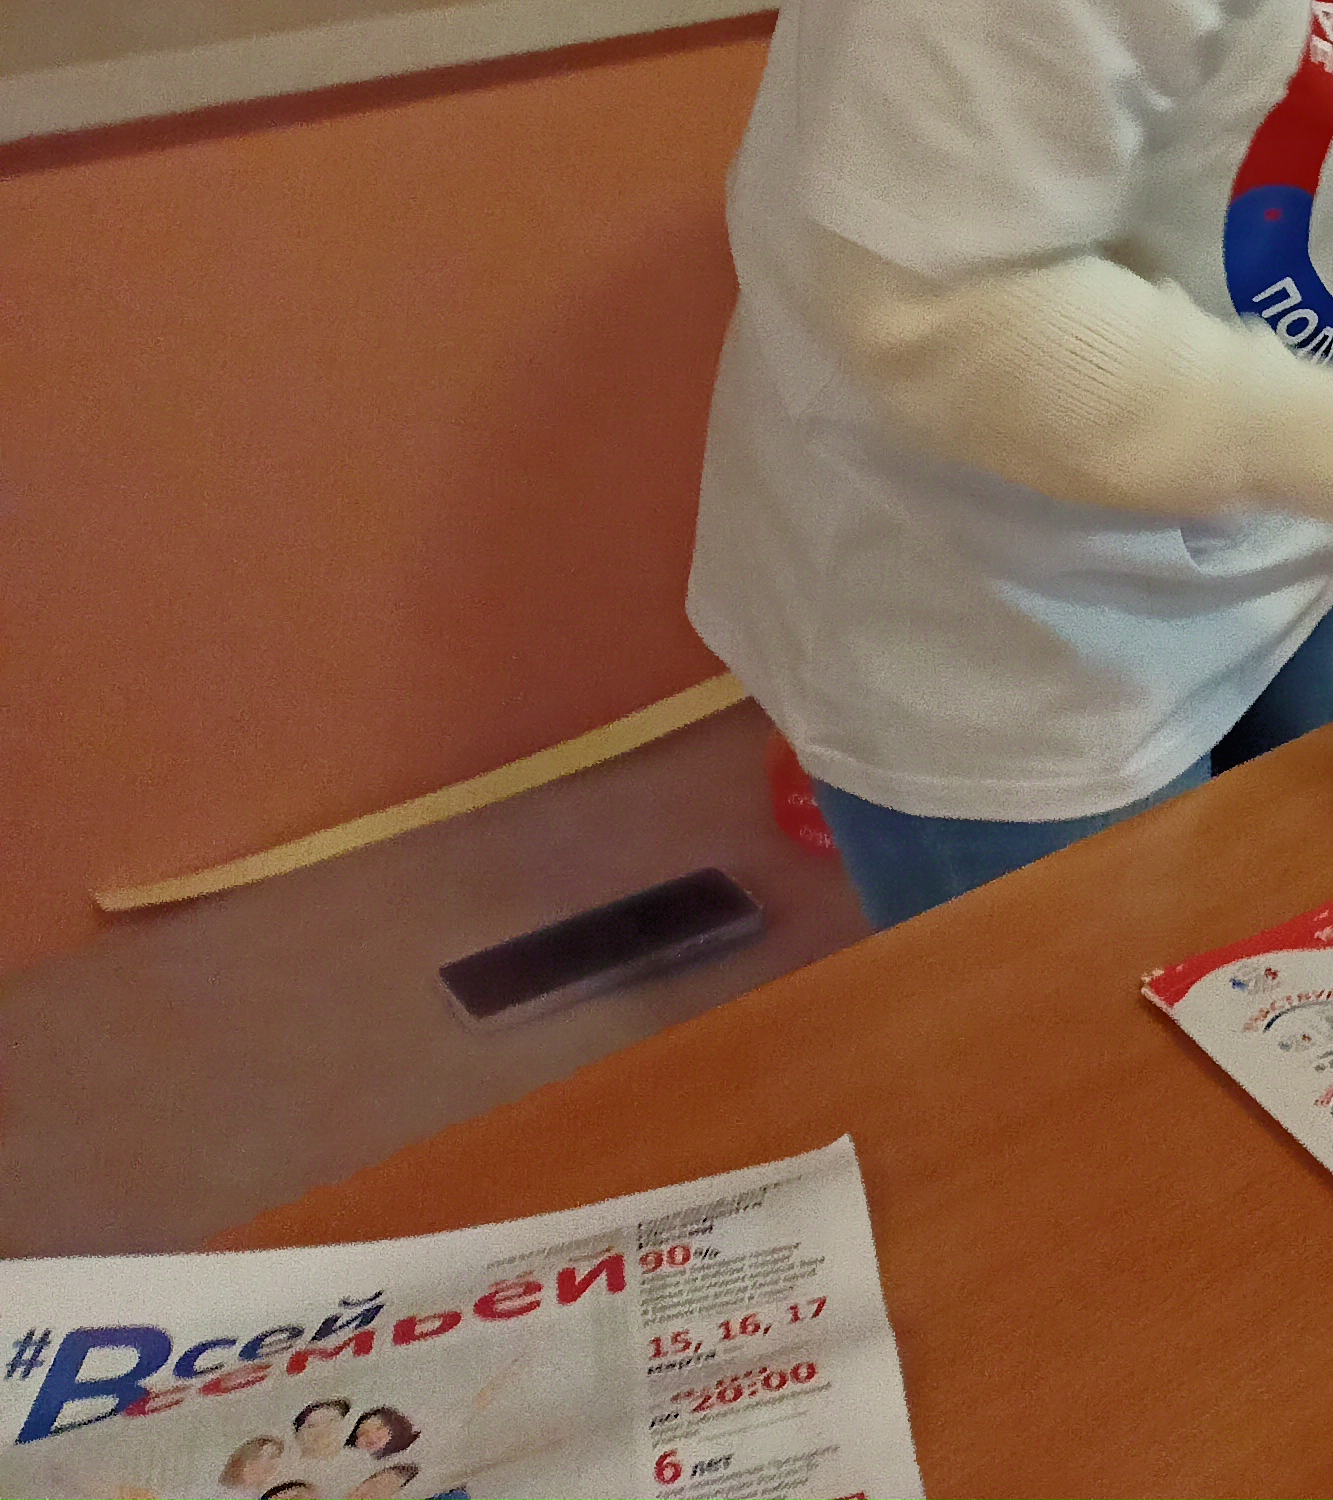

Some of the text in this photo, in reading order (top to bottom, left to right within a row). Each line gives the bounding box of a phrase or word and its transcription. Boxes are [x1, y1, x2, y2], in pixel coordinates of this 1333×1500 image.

[649, 1295, 828, 1360] 15, 16, 17
[653, 1448, 683, 1486] 6
